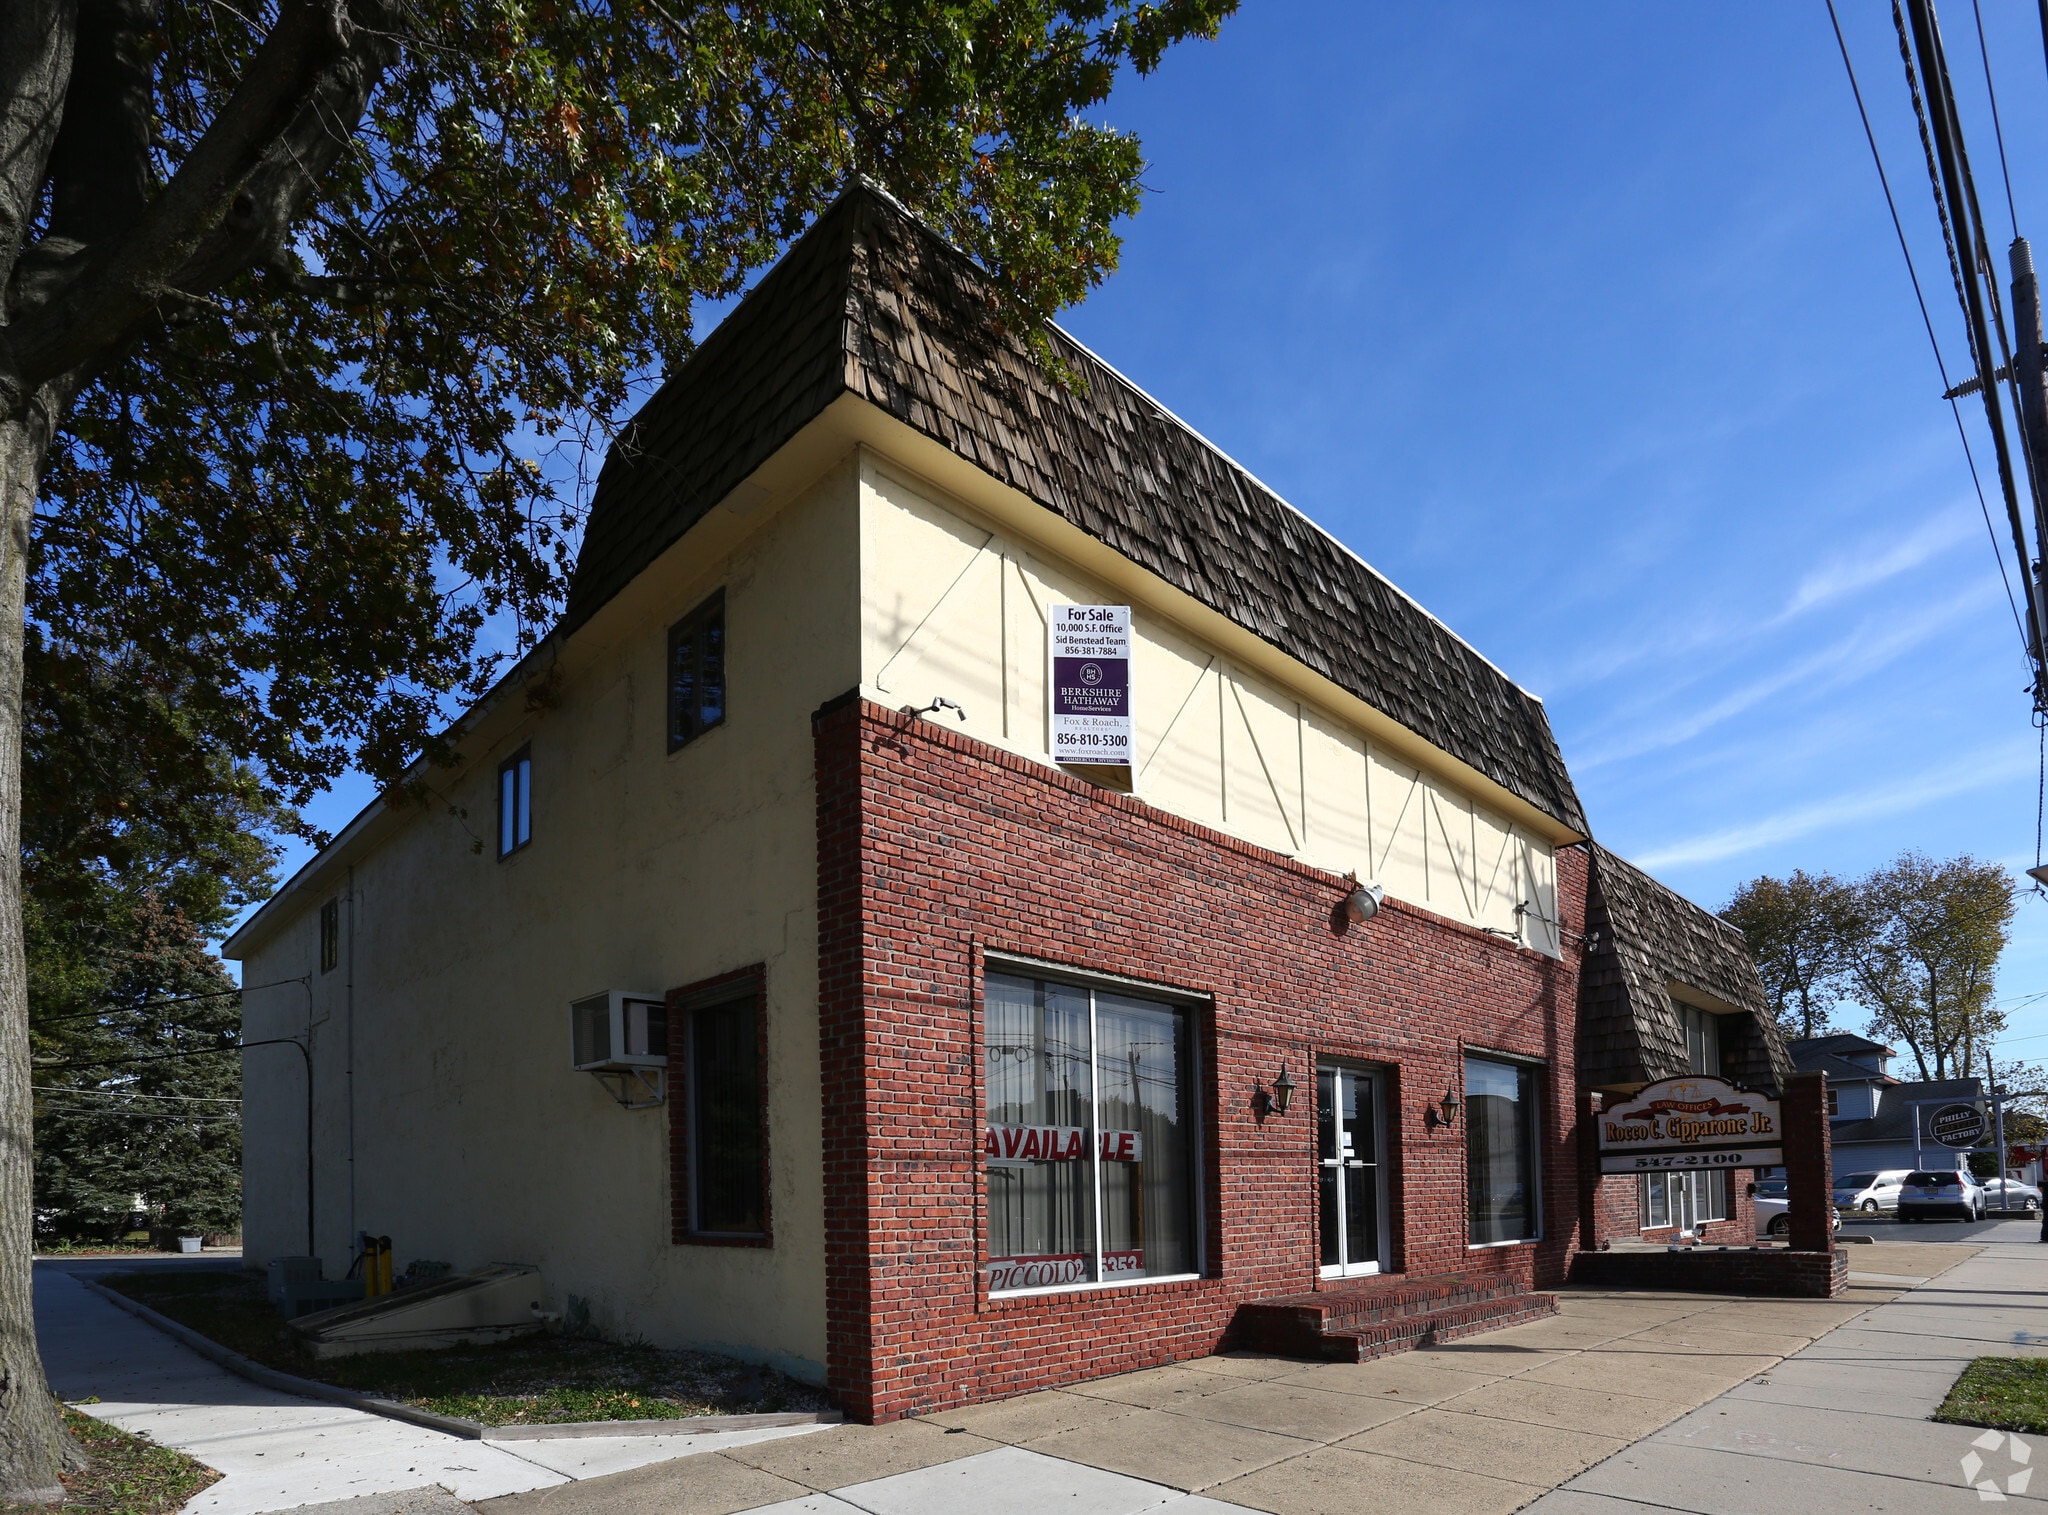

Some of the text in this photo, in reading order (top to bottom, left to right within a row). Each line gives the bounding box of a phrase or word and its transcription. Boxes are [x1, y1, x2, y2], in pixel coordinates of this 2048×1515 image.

[1068, 608, 1114, 621] For Sale
[1056, 623, 1123, 633] 10,000 S.F. Office
[1056, 635, 1126, 645] Sid Benstead Team
[1065, 646, 1117, 655] 856-381-7884
[1061, 687, 1122, 697] BERKSHIRE
[1064, 696, 1120, 706] HATHAWAY
[1064, 717, 1080, 726] Fox
[1082, 718, 1089, 726] &
[1057, 733, 1128, 747] 856-810-5300
[1059, 748, 1125, 756] www.foxroach.com
[1677, 1101, 1713, 1110] OFFICES
[1939, 1111, 1970, 1124] PHILLY
[1605, 1112, 1773, 1143] Rocco C. Cipparone Jr.
[1942, 1128, 1981, 1142] FACTORY
[986, 1127, 1134, 1160] AVAILALE
[1635, 1153, 1742, 1168] 547-2100
[989, 1260, 1078, 1290] PICCOLO
